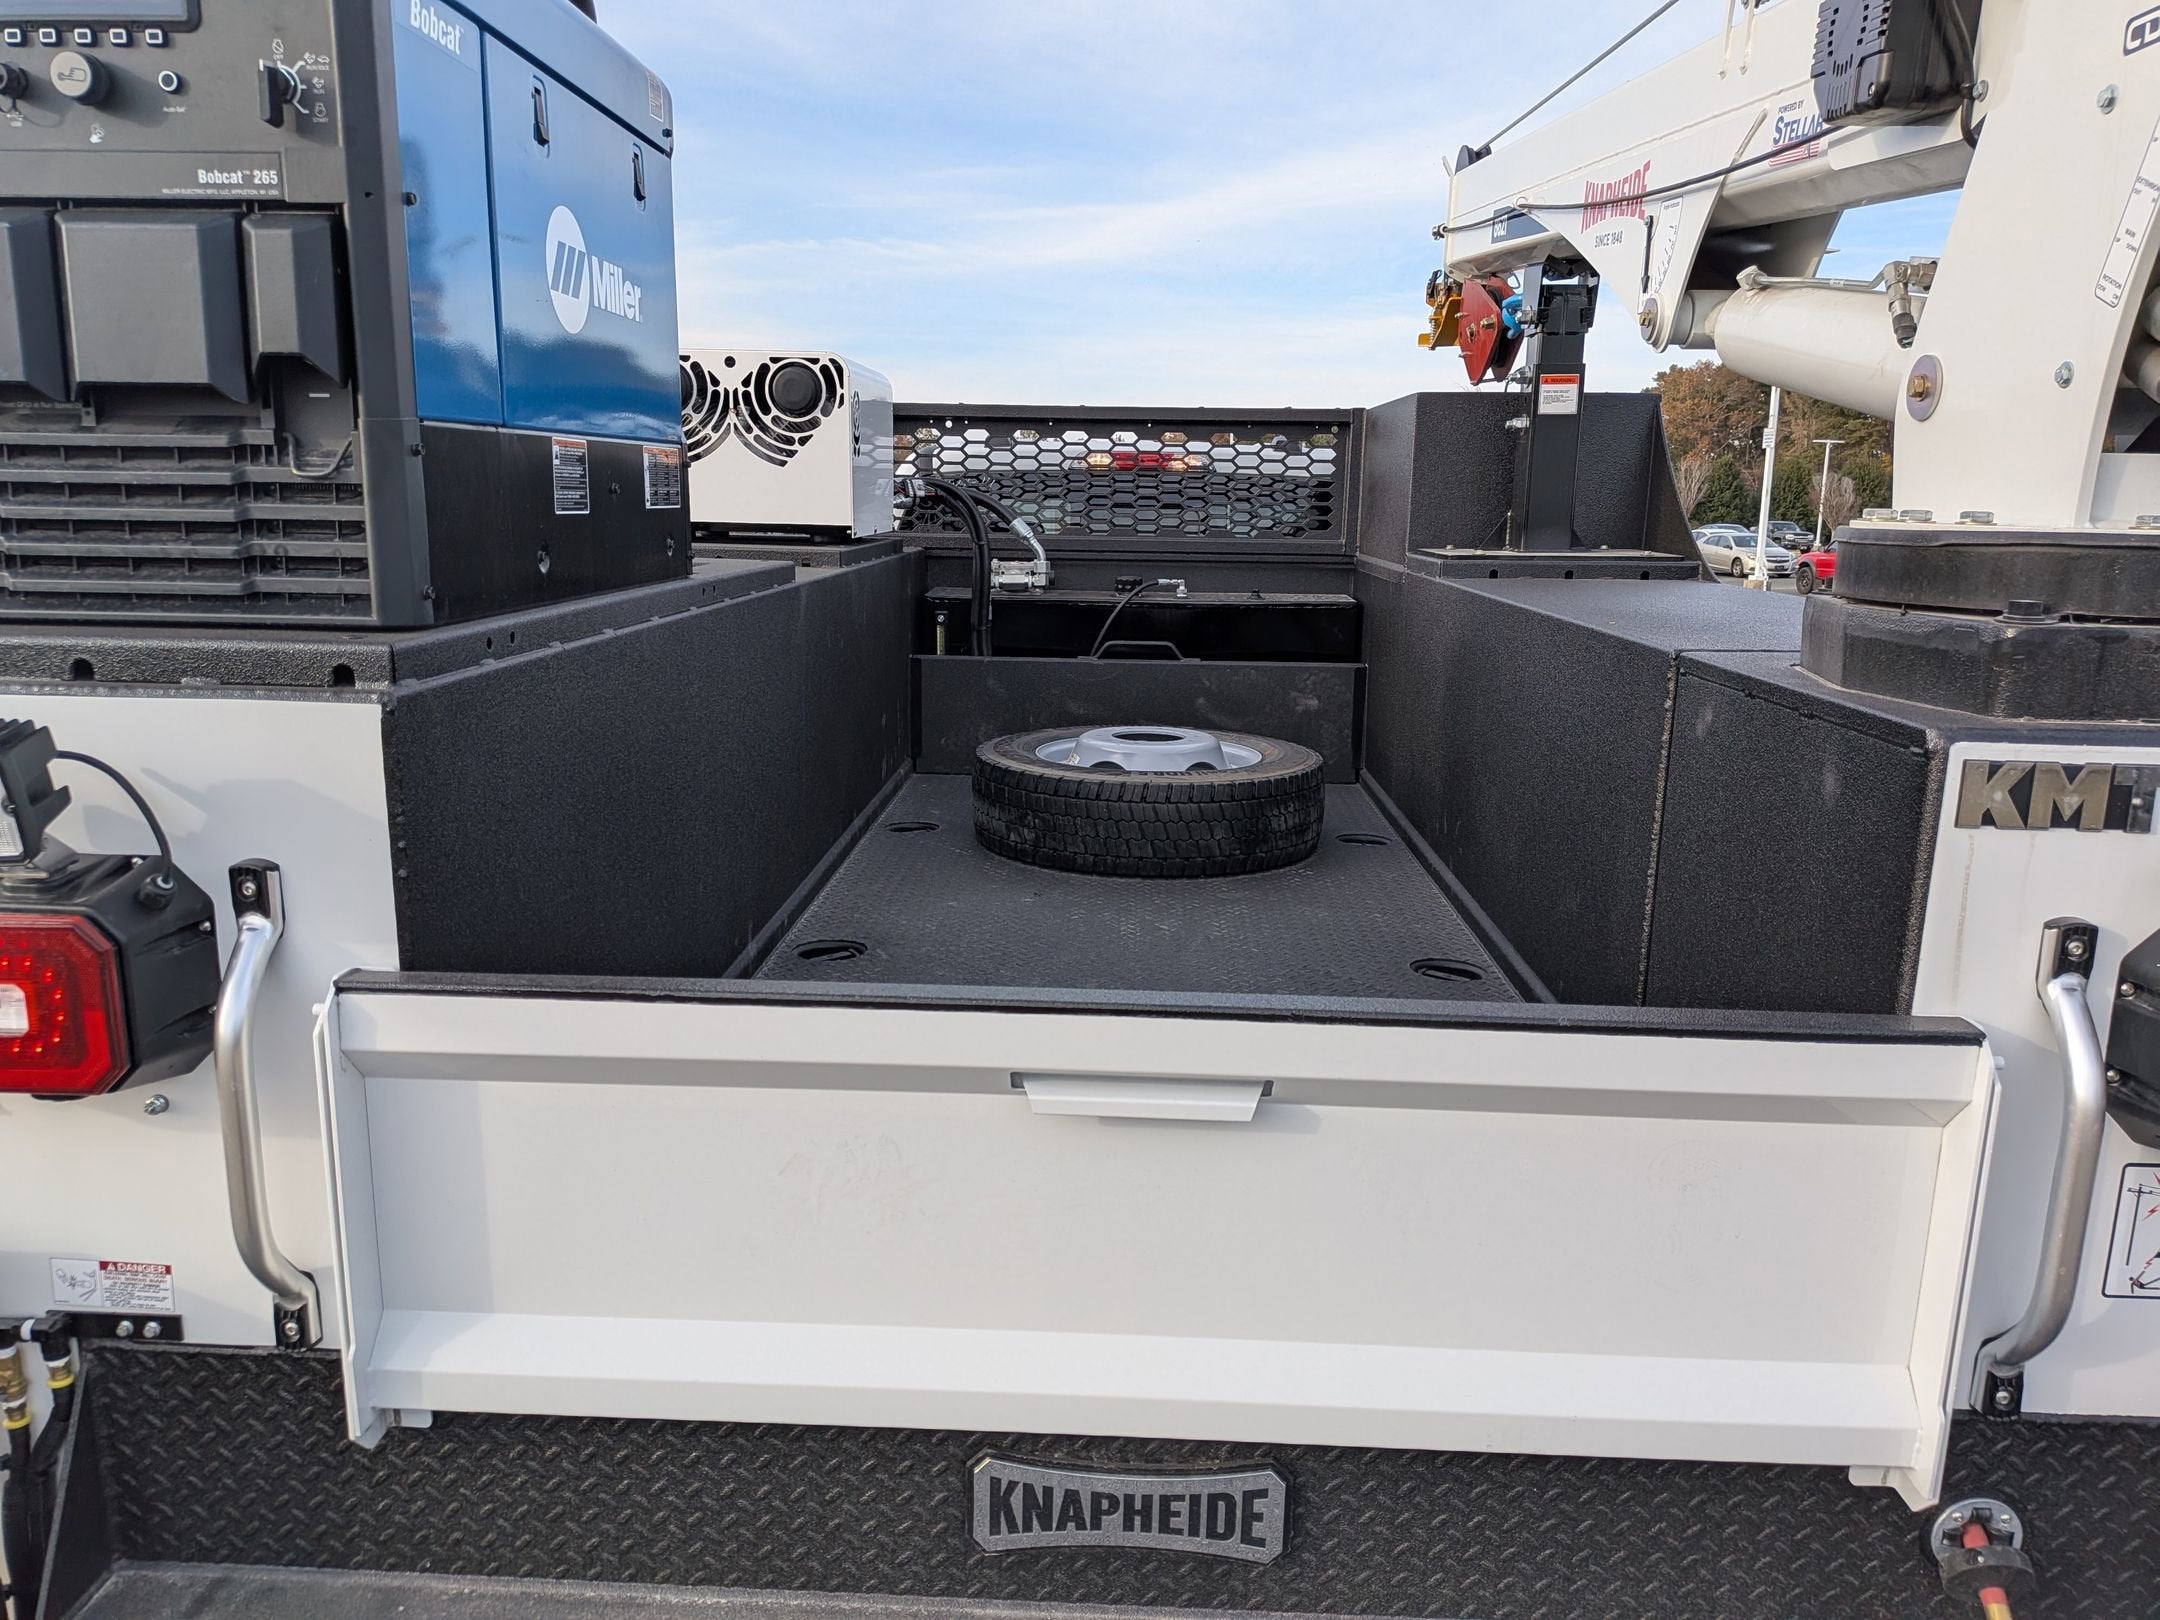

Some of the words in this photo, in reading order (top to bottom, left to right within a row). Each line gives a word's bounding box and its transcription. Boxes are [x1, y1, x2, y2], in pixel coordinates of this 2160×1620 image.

[1777, 101, 1798, 115] POWERED
[1797, 99, 1805, 110] BY
[1772, 113, 1825, 146] STELLAR
[253, 169, 279, 185] 265
[1580, 159, 1652, 234] KNAPHEIDE
[1594, 232, 1610, 248] SINCE
[1610, 230, 1623, 246] 1848
[591, 256, 642, 323] Miller
[2102, 273, 2123, 290] ROTATION
[117, 1263, 167, 1274] DANGER
[988, 1475, 1270, 1549] KNAPHEIDE
